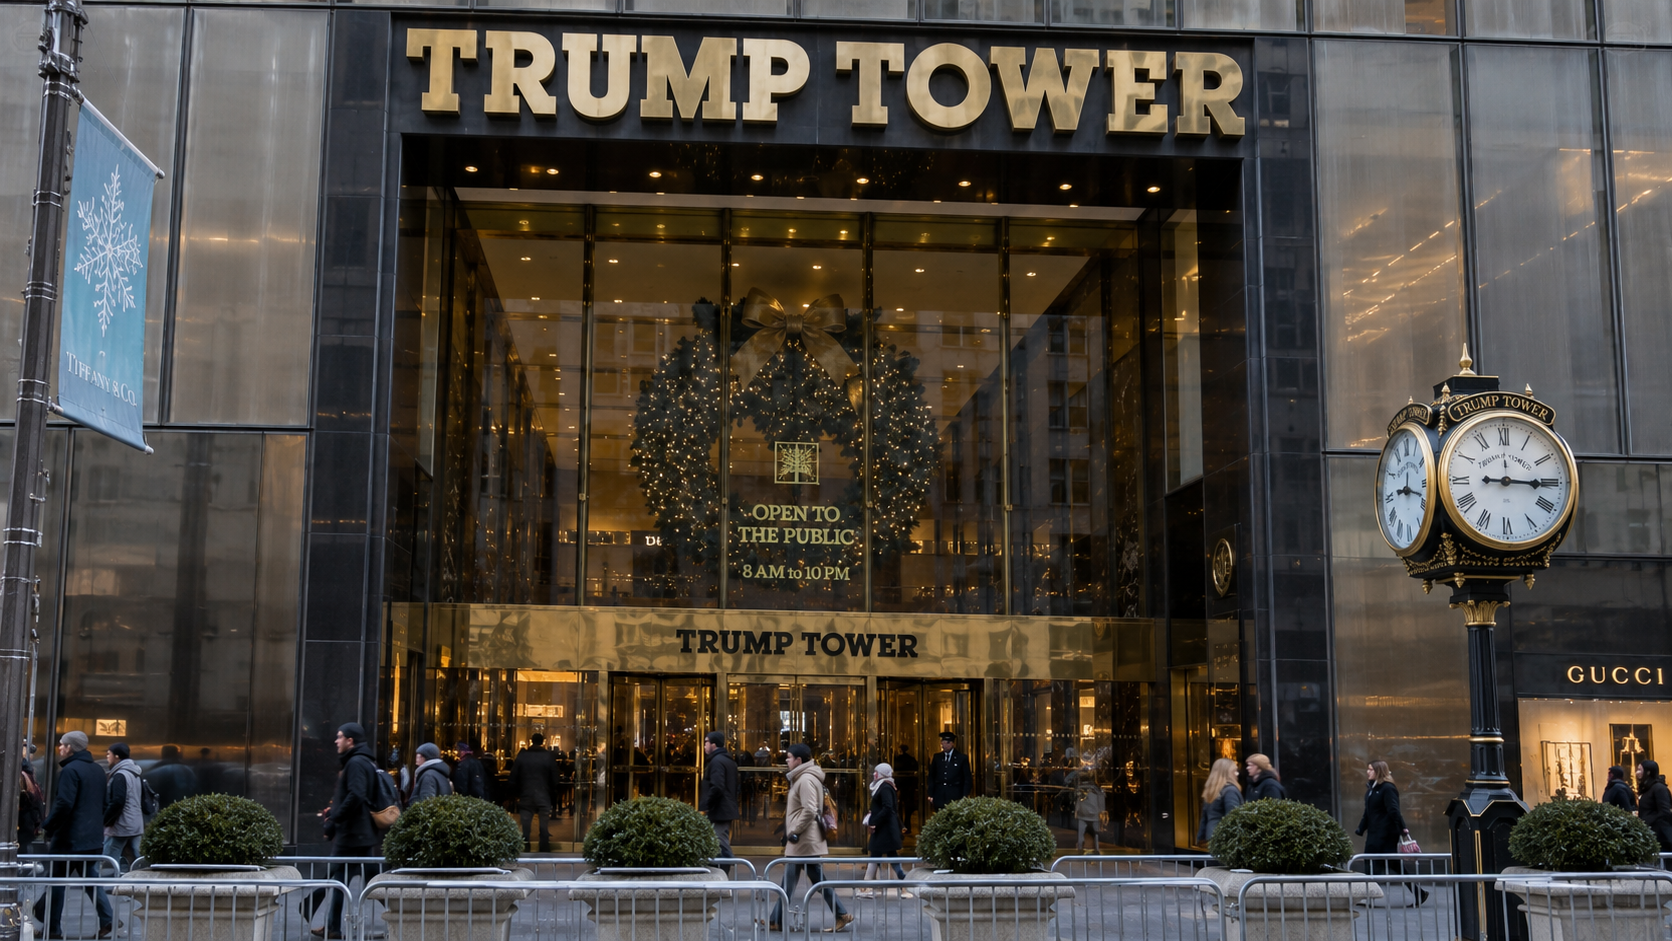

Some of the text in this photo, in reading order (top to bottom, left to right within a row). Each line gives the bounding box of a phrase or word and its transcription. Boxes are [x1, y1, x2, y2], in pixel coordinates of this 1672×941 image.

[406, 28, 1245, 138] TRUMP TOWER
[66, 351, 111, 393] TIFFANY
[112, 380, 120, 398] &
[1454, 395, 1499, 417] TRUMP
[1502, 395, 1548, 421] TOWER
[1498, 428, 1510, 446] XII
[752, 504, 841, 522] OPEN TO
[738, 526, 855, 545] THE PUBLIC
[742, 564, 851, 581] 8 AM to 10 PM
[676, 629, 918, 658] TRUMP TOWER
[1567, 665, 1664, 685] GUCCI
